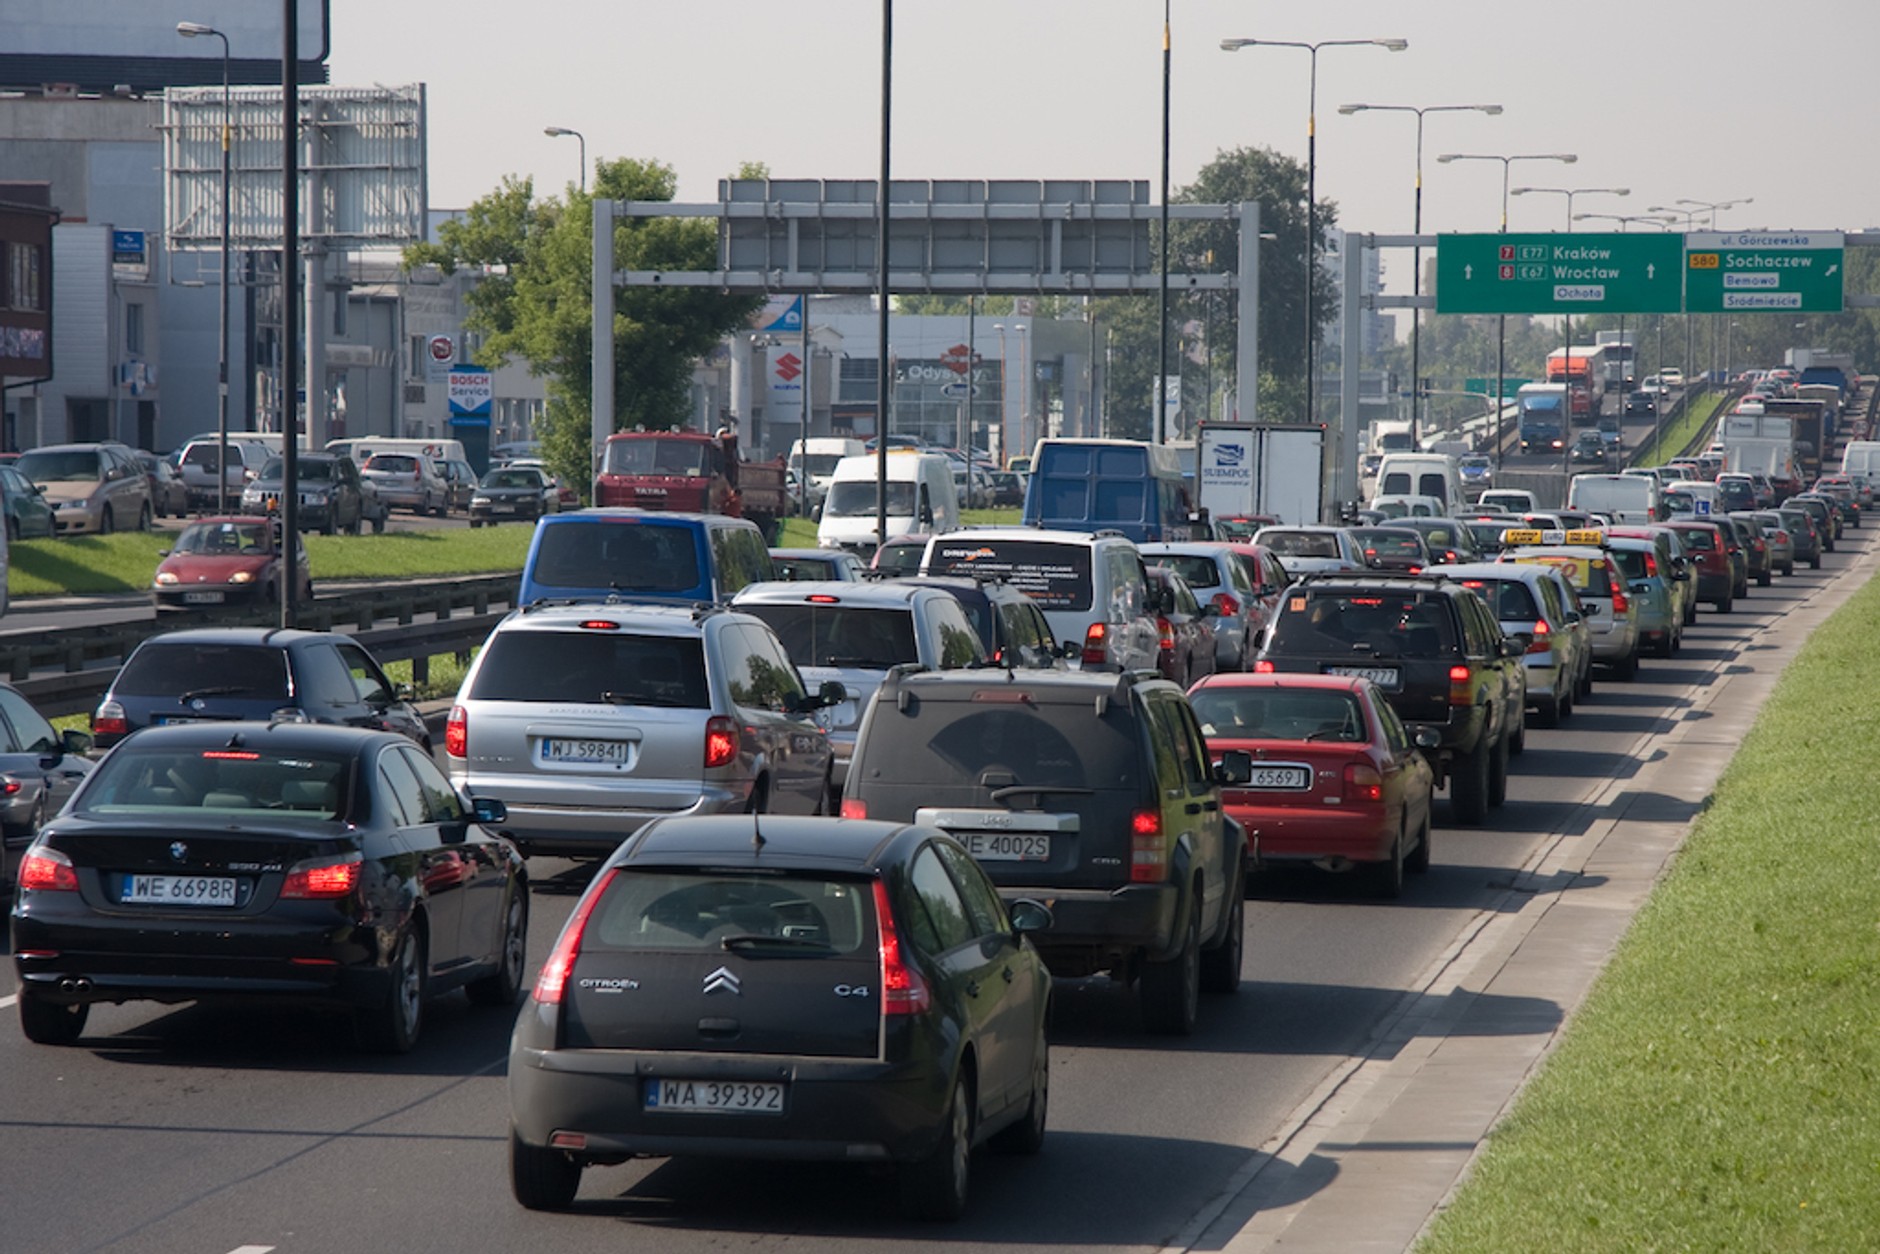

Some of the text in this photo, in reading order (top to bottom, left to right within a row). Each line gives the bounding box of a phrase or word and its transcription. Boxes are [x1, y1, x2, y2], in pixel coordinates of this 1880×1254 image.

[1721, 235, 1809, 246] ul. Górczewska
[1503, 248, 1511, 258] 7
[1553, 246, 1611, 260] Kraków
[1692, 253, 1812, 268] 580 Sochaczew
[1503, 267, 1511, 277] 8
[1552, 265, 1620, 279] Wrocław
[1726, 276, 1777, 286] Bemowo
[1557, 287, 1602, 298] Ochota
[1727, 294, 1799, 307] Śródmieście
[450, 375, 489, 385] BOSCH
[450, 387, 490, 396] Service
[1203, 468, 1251, 478] SUEMPOL
[634, 486, 668, 495] TATRA
[552, 741, 623, 758] WJ 59841
[989, 836, 1048, 856] 4002S
[135, 878, 234, 900] WE 6698R
[834, 984, 870, 997] C4
[664, 1082, 781, 1109] WA 39392
